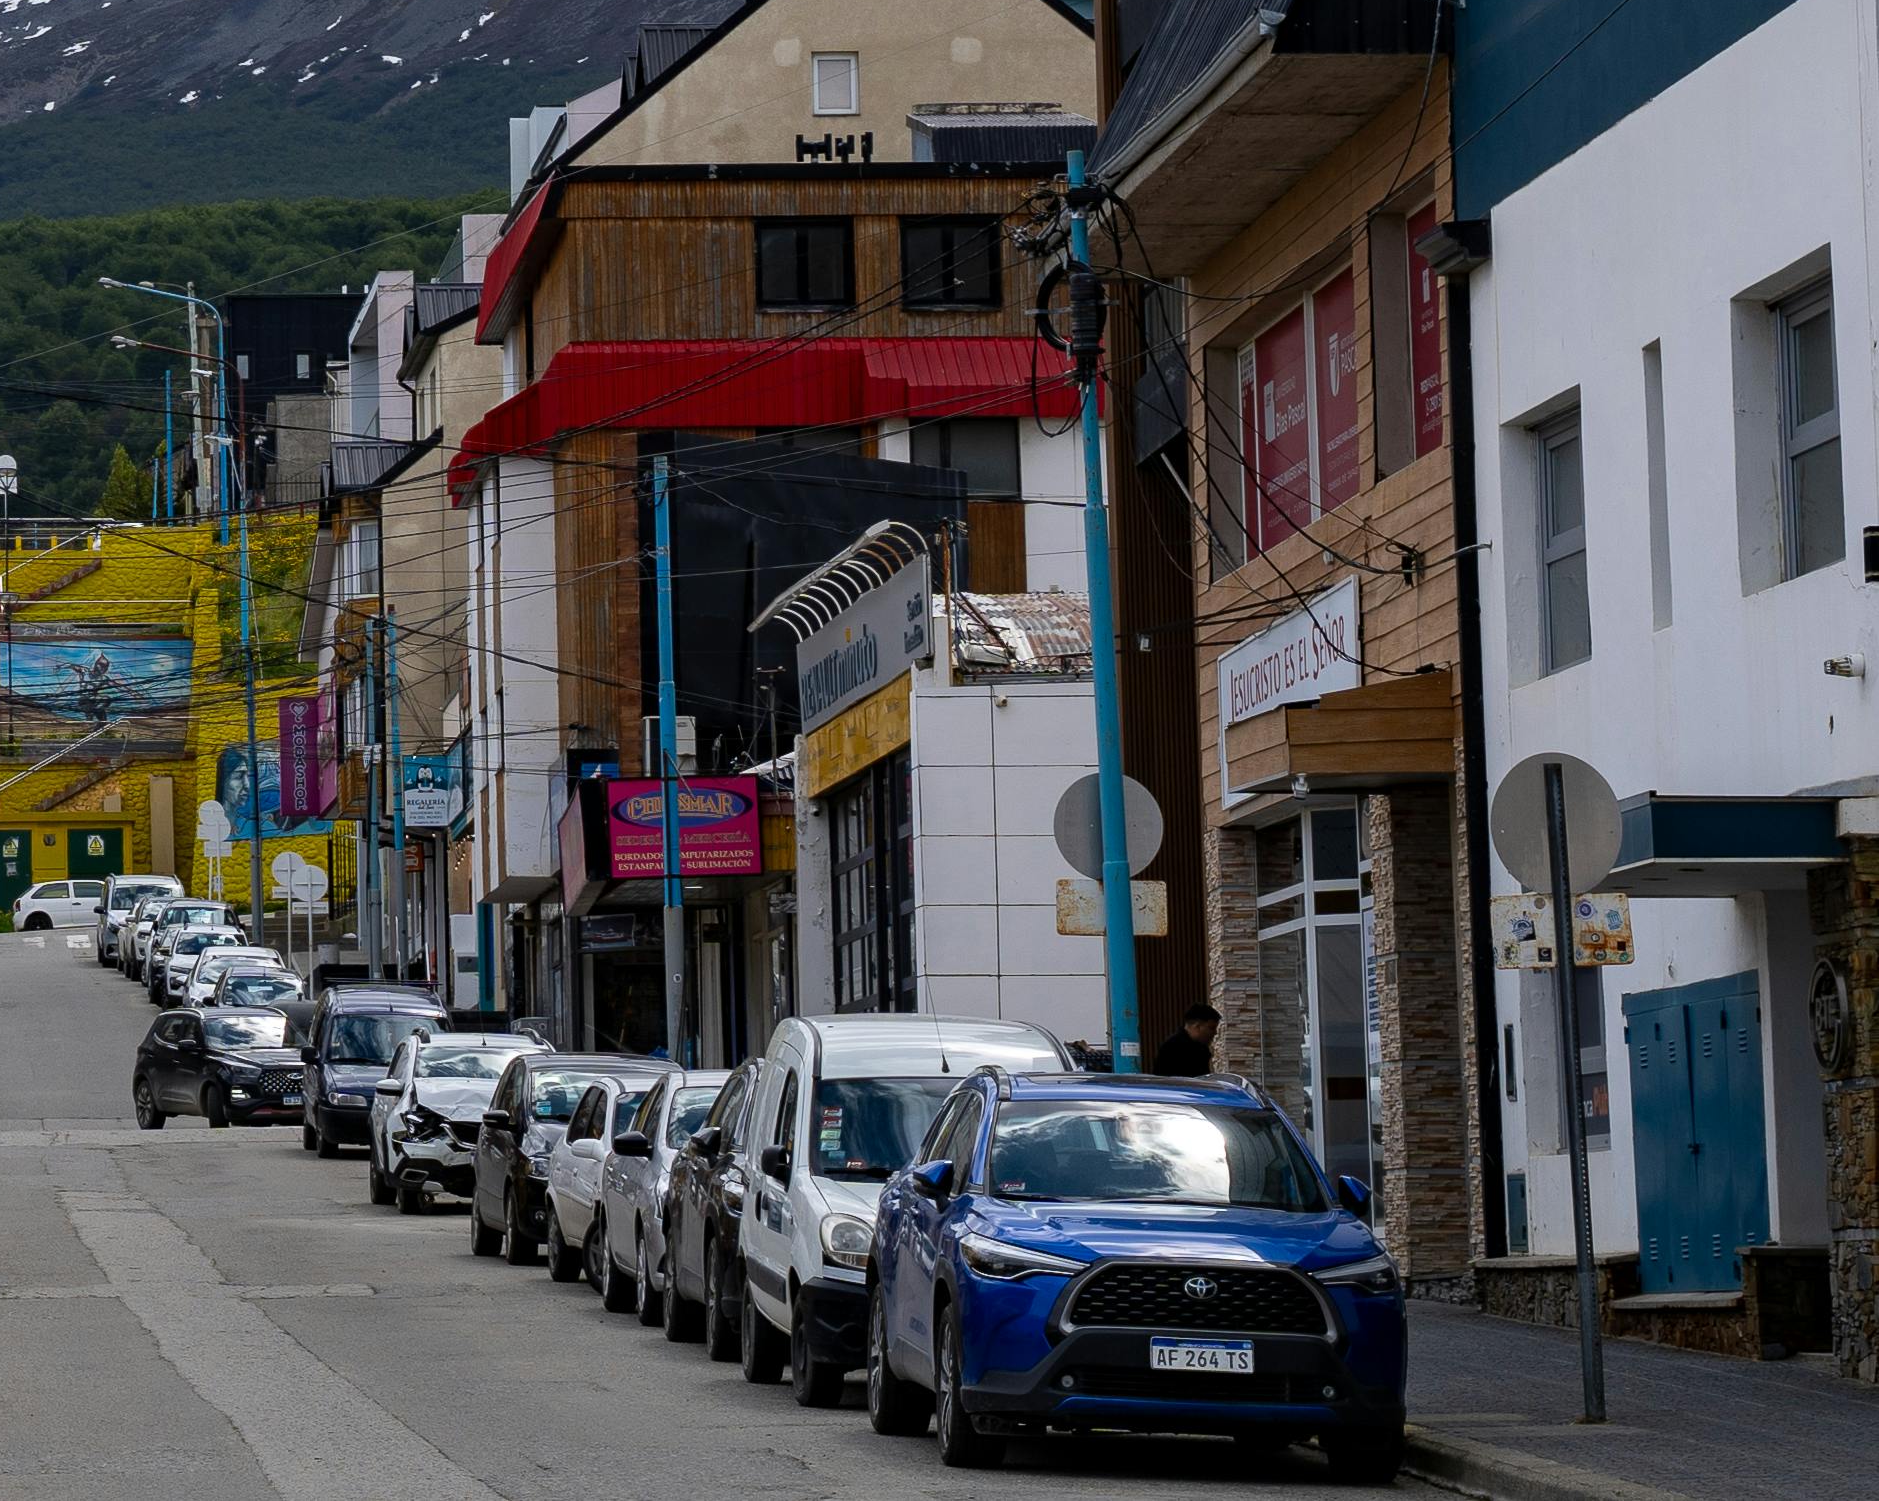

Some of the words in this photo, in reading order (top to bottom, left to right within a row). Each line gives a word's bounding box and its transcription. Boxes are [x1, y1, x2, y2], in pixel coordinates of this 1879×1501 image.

[1230, 652, 1281, 723] JESUCRISTO
[1284, 644, 1295, 689] ES
[1298, 637, 1309, 681] EL
[685, 830, 751, 844] MERCERÍA
[680, 849, 754, 858] MPUTARIZADOS
[687, 859, 751, 868] SUBLIMACIÓN
[1157, 1349, 1178, 1366] AF
[1185, 1350, 1219, 1368] 264
[1226, 1352, 1248, 1369] TS
